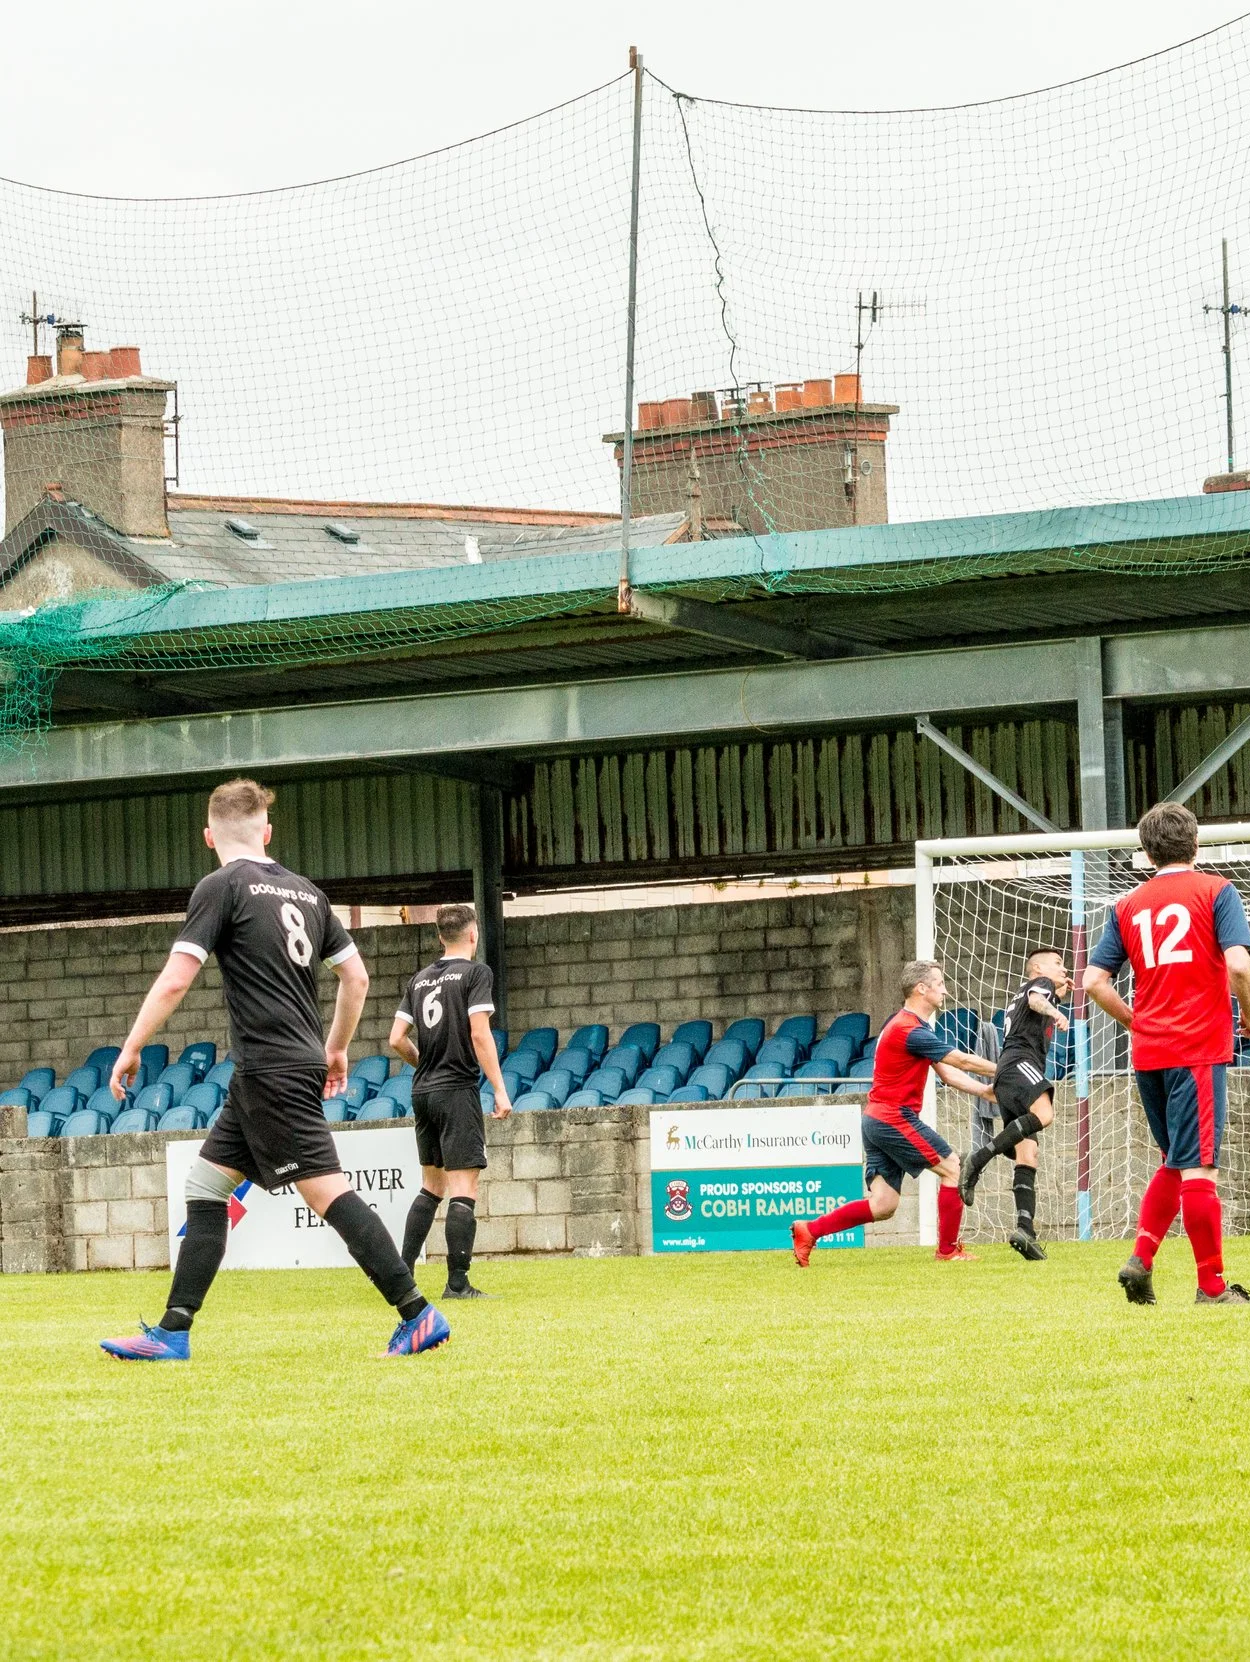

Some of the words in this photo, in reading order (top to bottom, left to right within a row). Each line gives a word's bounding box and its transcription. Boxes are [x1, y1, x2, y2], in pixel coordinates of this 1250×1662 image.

[298, 891, 318, 906] COW
[281, 902, 313, 968] 8
[1131, 903, 1193, 969] 12
[444, 973, 463, 981] COW
[422, 986, 443, 1029] 6
[685, 1133, 743, 1152] McCarthy
[747, 1133, 808, 1148] Insurance
[811, 1130, 850, 1149] Group
[700, 1183, 738, 1196] PROUD
[741, 1181, 803, 1195] SPONSORS
[806, 1180, 822, 1193] OF
[700, 1199, 750, 1217] COBH
[846, 1232, 854, 1242] 11
